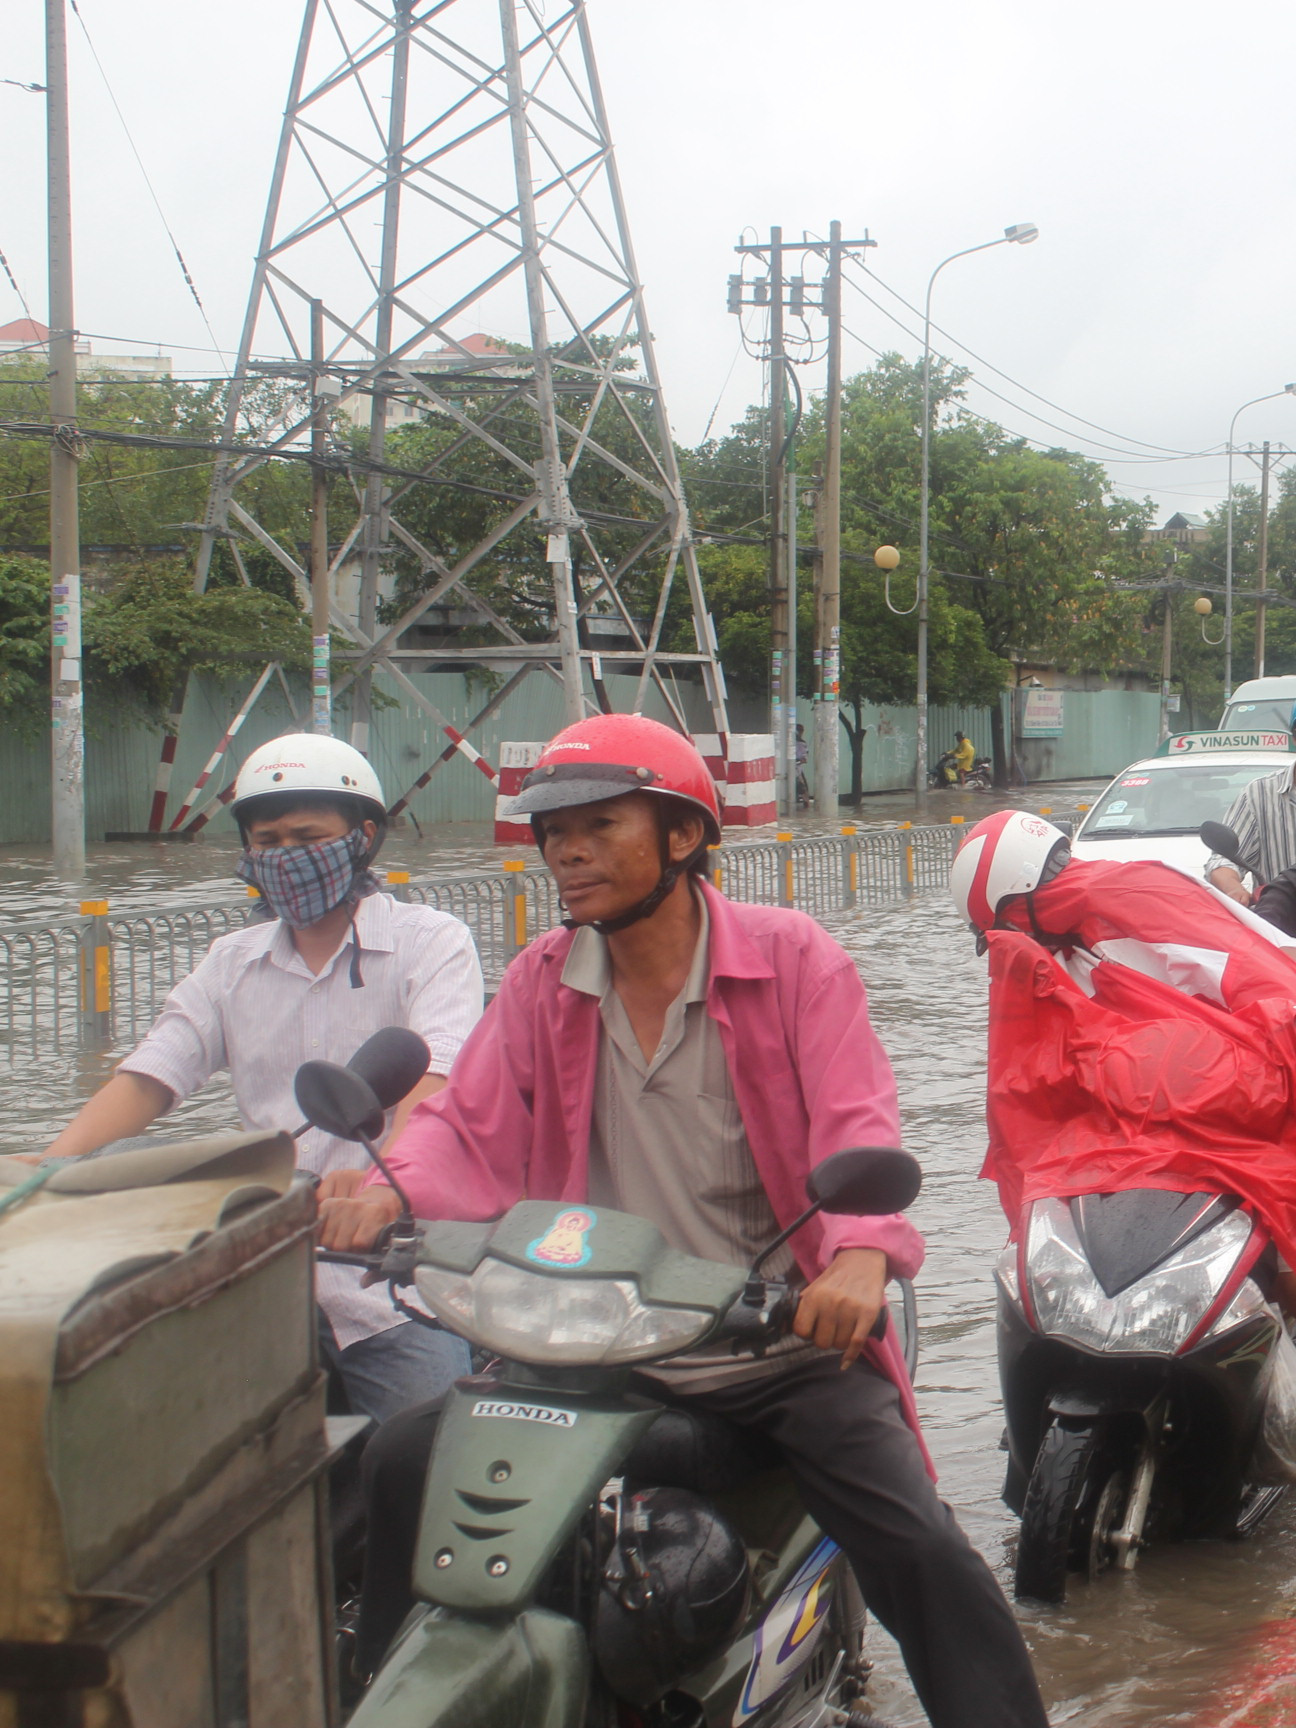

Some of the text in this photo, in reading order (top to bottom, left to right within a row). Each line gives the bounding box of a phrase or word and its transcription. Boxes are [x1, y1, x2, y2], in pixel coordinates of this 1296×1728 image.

[1200, 734, 1287, 748] VINASUN TAXI
[264, 762, 306, 770] HONDA
[476, 1403, 571, 1425] HONDA
